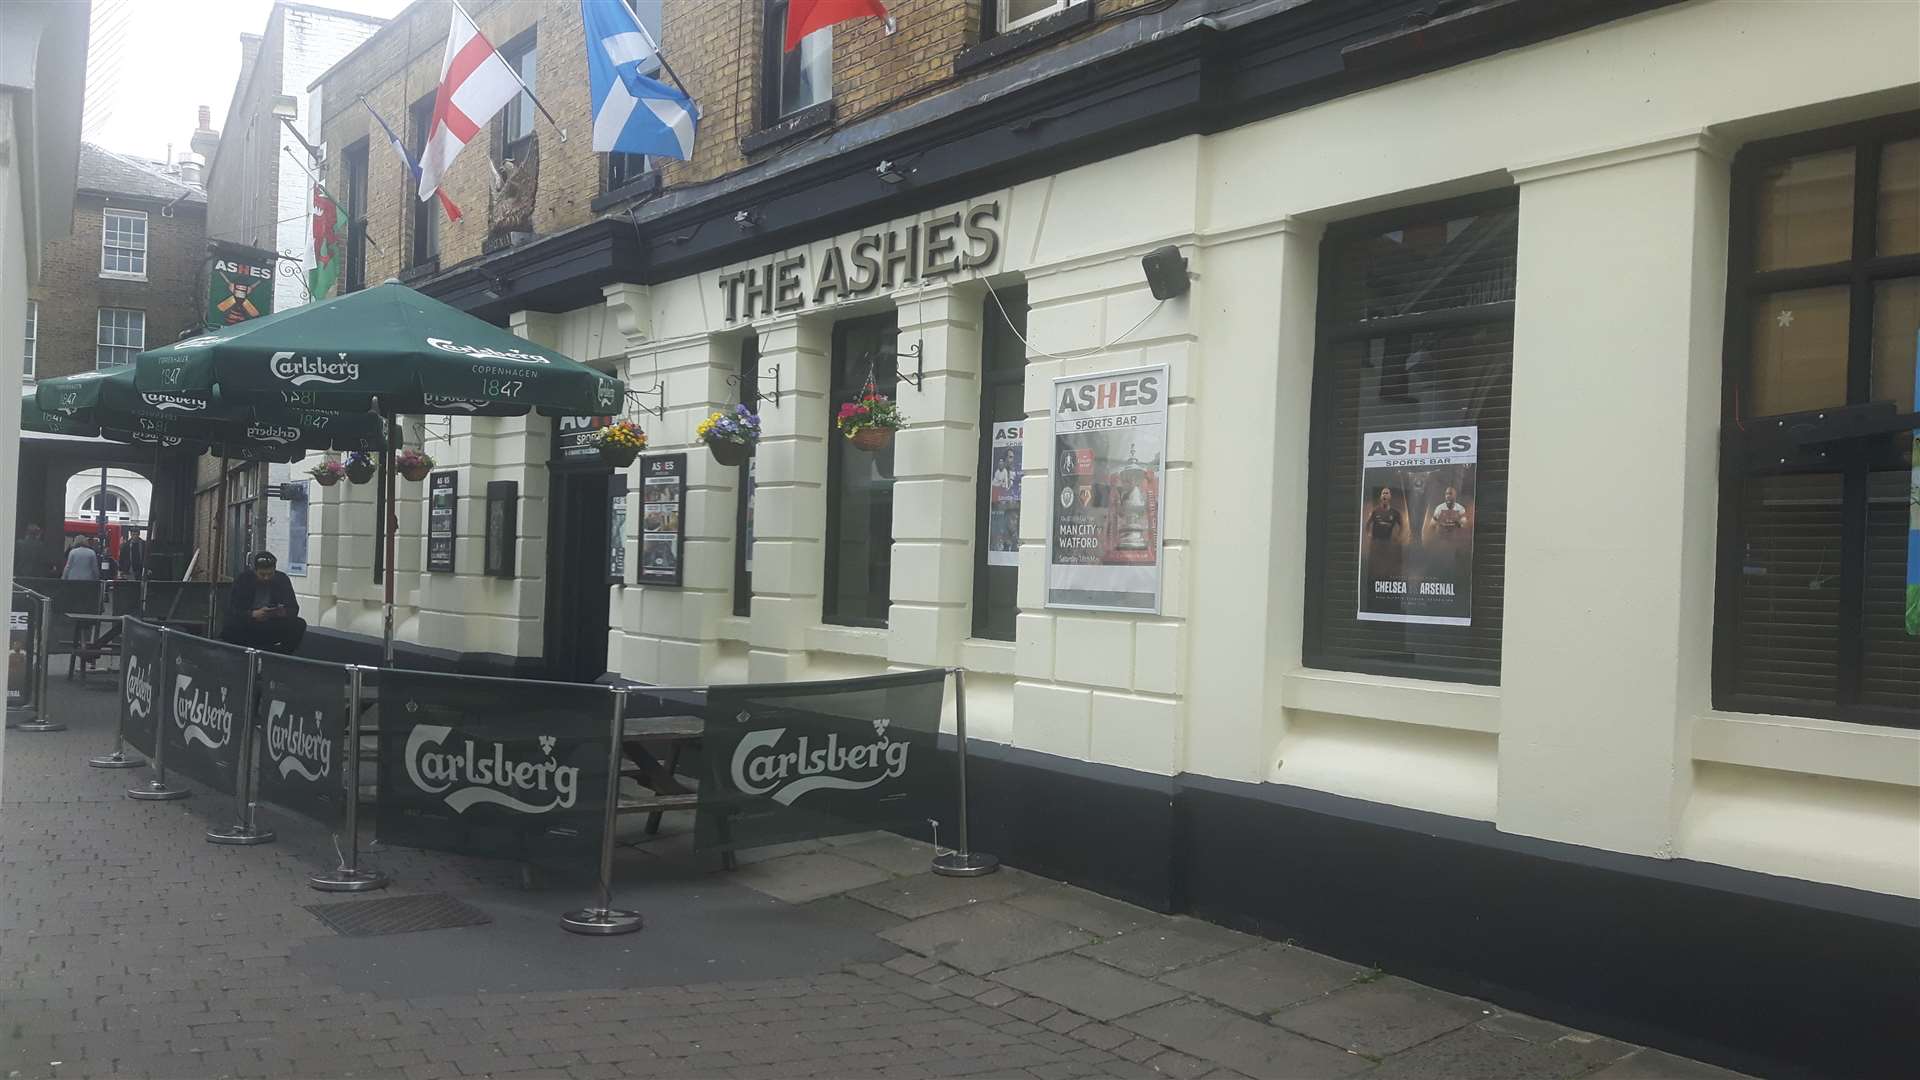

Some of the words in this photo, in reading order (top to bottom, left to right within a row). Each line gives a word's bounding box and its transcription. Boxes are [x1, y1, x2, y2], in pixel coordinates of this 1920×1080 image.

[215, 260, 271, 279] ASHES
[719, 255, 804, 321] THE
[812, 200, 999, 303] ASHES
[427, 338, 550, 363] Carlsberg
[270, 351, 359, 386] Carlsberg
[472, 364, 538, 378] COPENHAGEN
[482, 379, 523, 398] 1847
[1058, 376, 1158, 414] ASHES
[1075, 417, 1113, 430] SPORTS
[1116, 415, 1138, 426] BAR
[1368, 435, 1471, 457] ASHES
[1386, 458, 1425, 467] SPORTS
[1430, 457, 1450, 465] BAR
[1059, 524, 1078, 535] MAN
[1078, 524, 1097, 535] CITY
[1059, 537, 1098, 548] WATFORD
[1375, 580, 1407, 594] CHELSEA
[1420, 582, 1455, 596] ARSENAL
[173, 674, 233, 749] Carlsberg
[266, 700, 331, 782] Carlsberg
[405, 723, 579, 814] Carlsberg
[731, 720, 911, 806] Carlsberg
